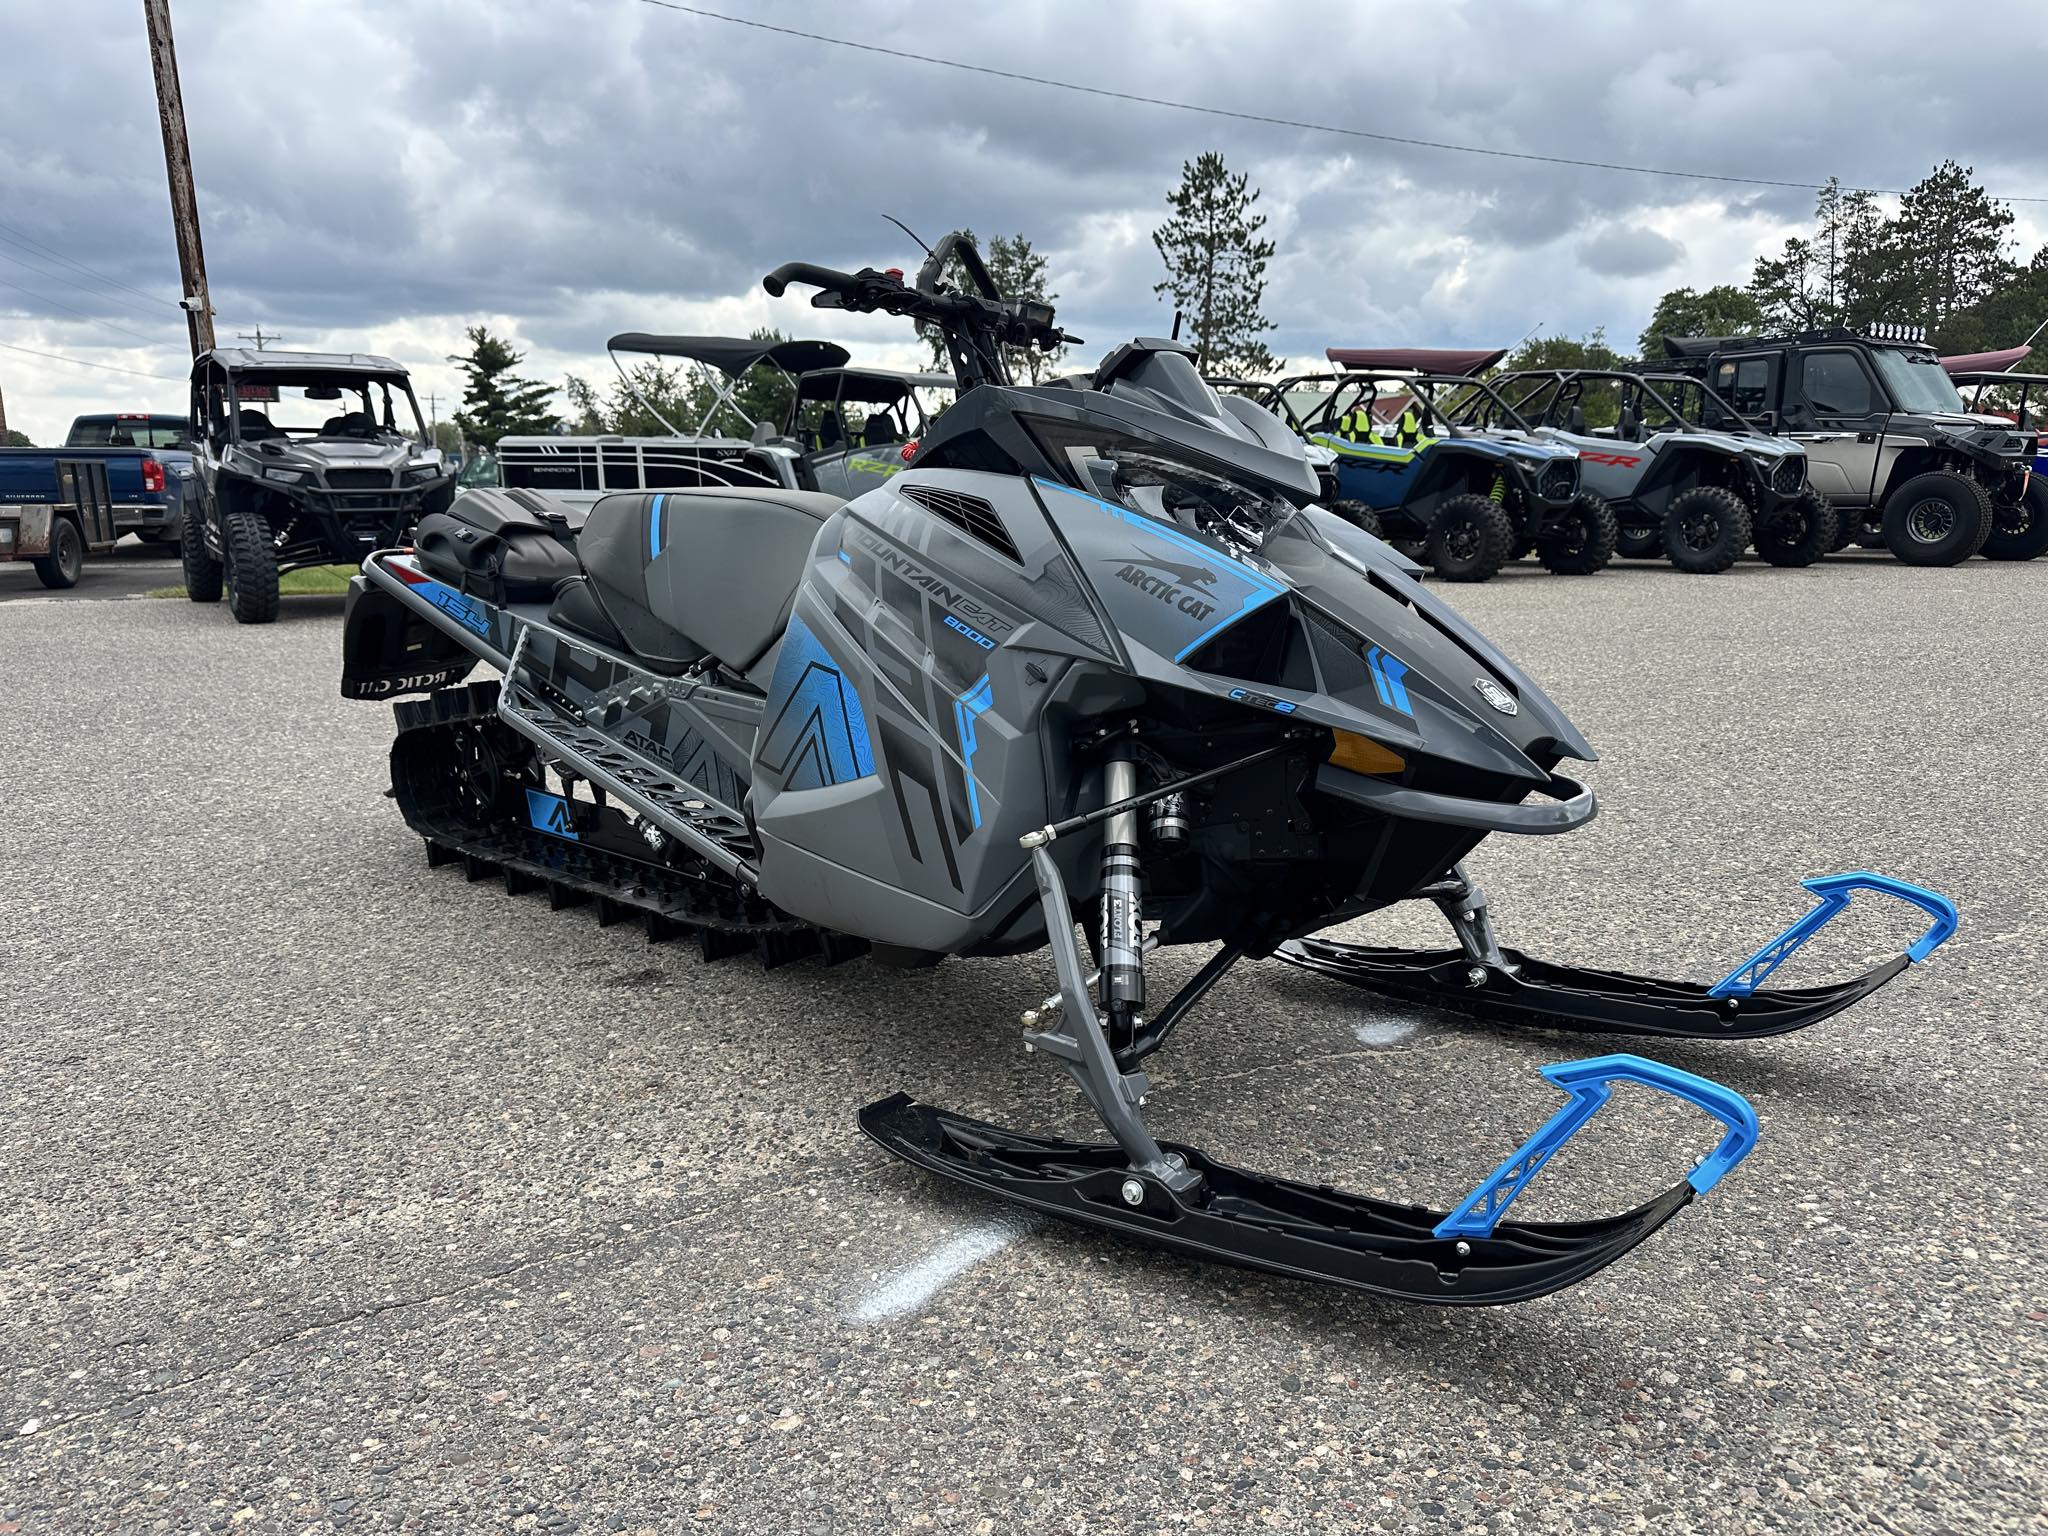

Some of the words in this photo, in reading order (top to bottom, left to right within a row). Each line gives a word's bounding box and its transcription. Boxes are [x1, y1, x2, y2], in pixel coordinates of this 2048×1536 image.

[437, 590, 489, 635] 154
[1115, 565, 1182, 604] ARCTIC
[1177, 596, 1216, 622] CAT
[943, 615, 997, 651] 8000
[624, 729, 673, 764] ATAC
[1127, 891, 1143, 949] FOX
